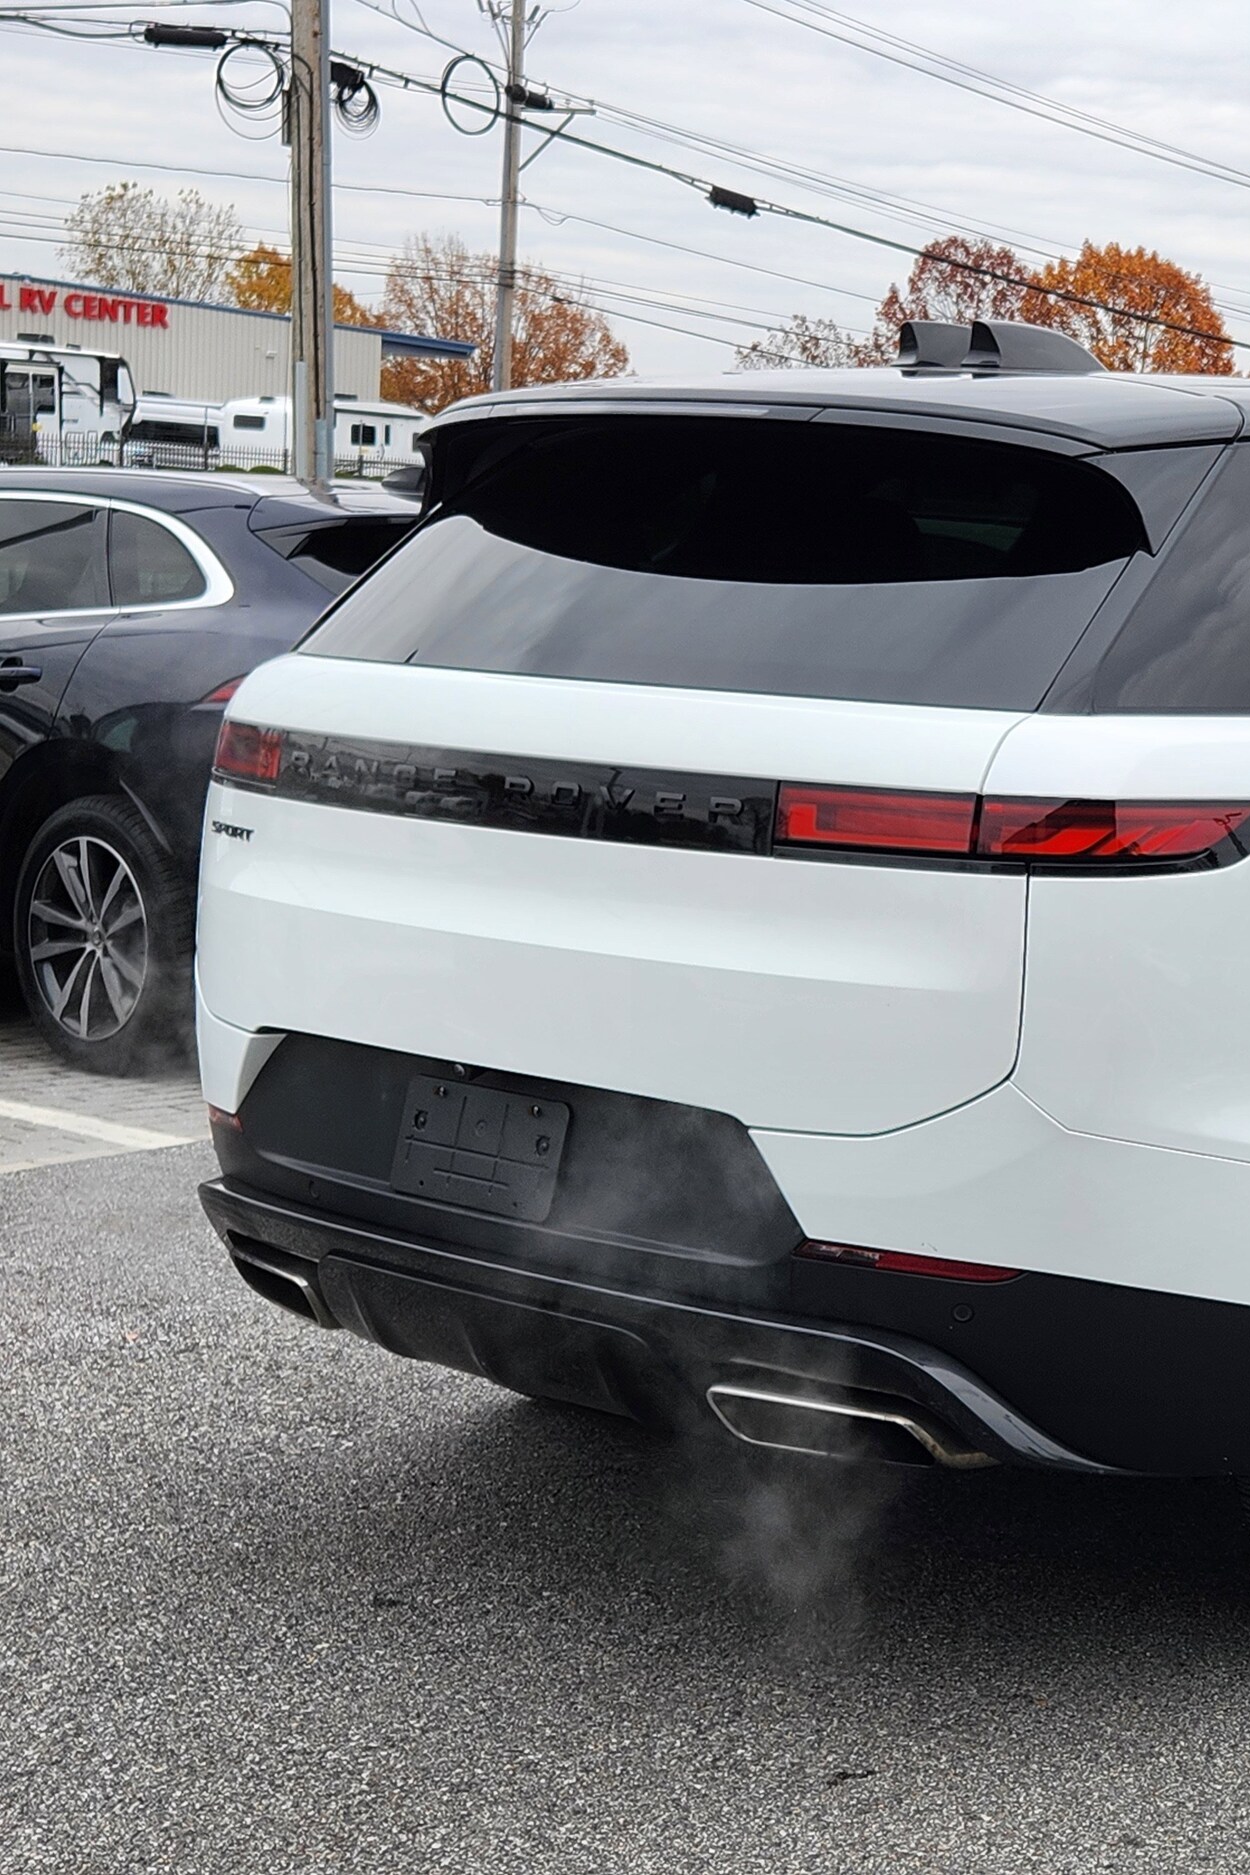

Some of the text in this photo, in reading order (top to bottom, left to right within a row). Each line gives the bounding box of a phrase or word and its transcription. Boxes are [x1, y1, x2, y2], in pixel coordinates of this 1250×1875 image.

[19, 287, 57, 315] RV
[64, 293, 169, 329] CENTER
[290, 750, 744, 825] RANGE ROVER
[211, 820, 254, 843] SPORT
